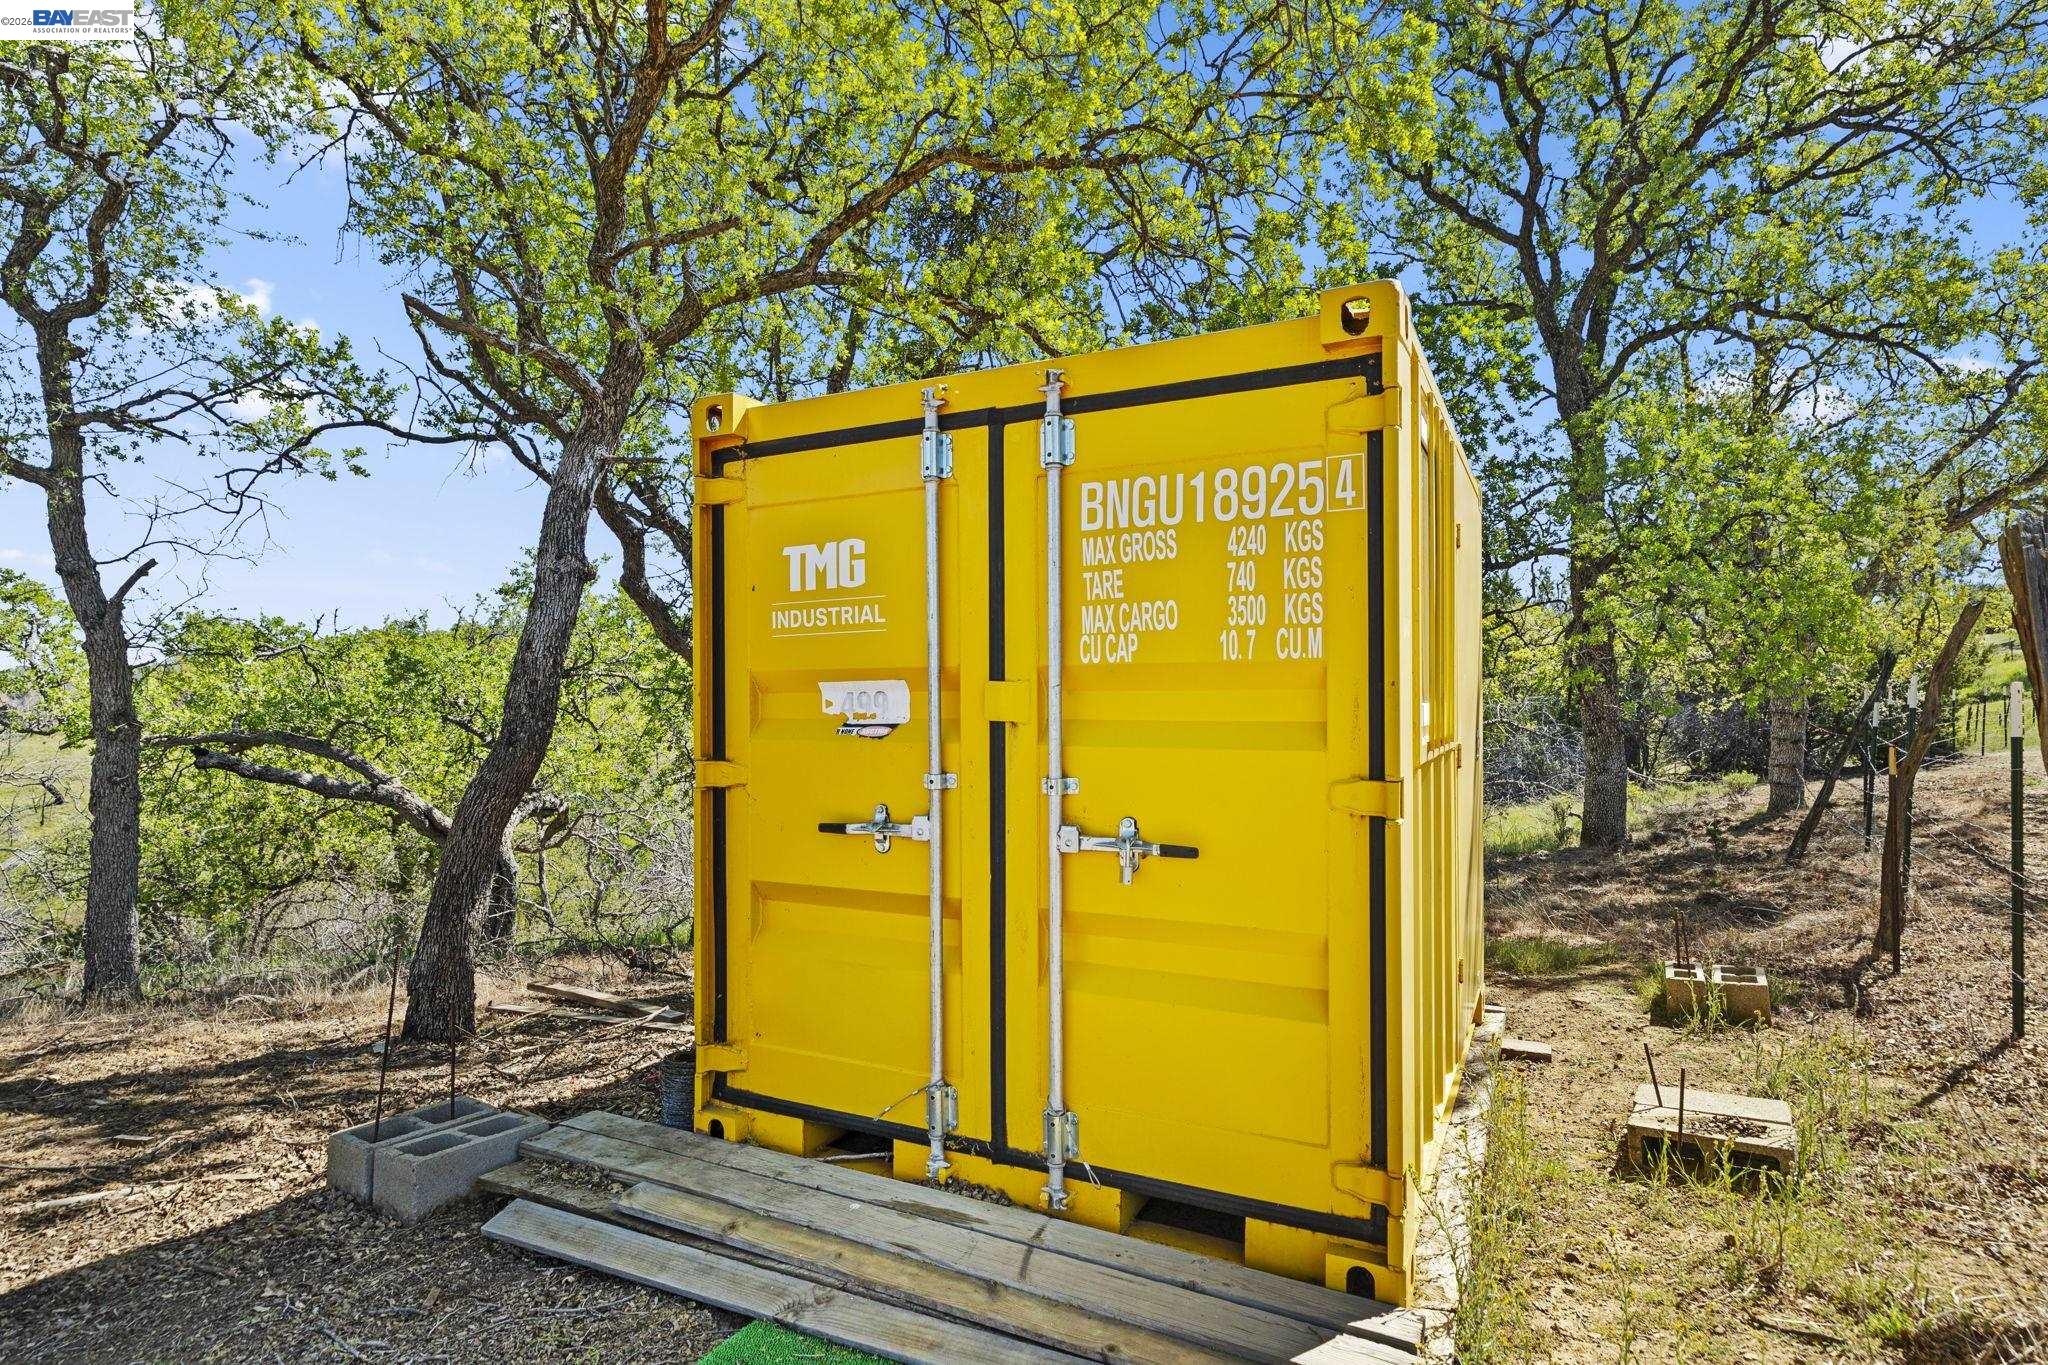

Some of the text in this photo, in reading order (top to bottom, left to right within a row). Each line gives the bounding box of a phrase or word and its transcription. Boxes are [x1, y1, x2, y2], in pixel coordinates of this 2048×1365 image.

[1082, 519, 1324, 567] MAX GROSS 4240 KGS
[783, 538, 866, 592] TMG
[1083, 556, 1323, 600] TARE 740 KGS
[772, 604, 886, 629] INDUSTRIAL
[1081, 592, 1324, 634] MAX CARGO 3500 KGS
[1079, 634, 1101, 664] CU
[1105, 633, 1139, 663] CAP
